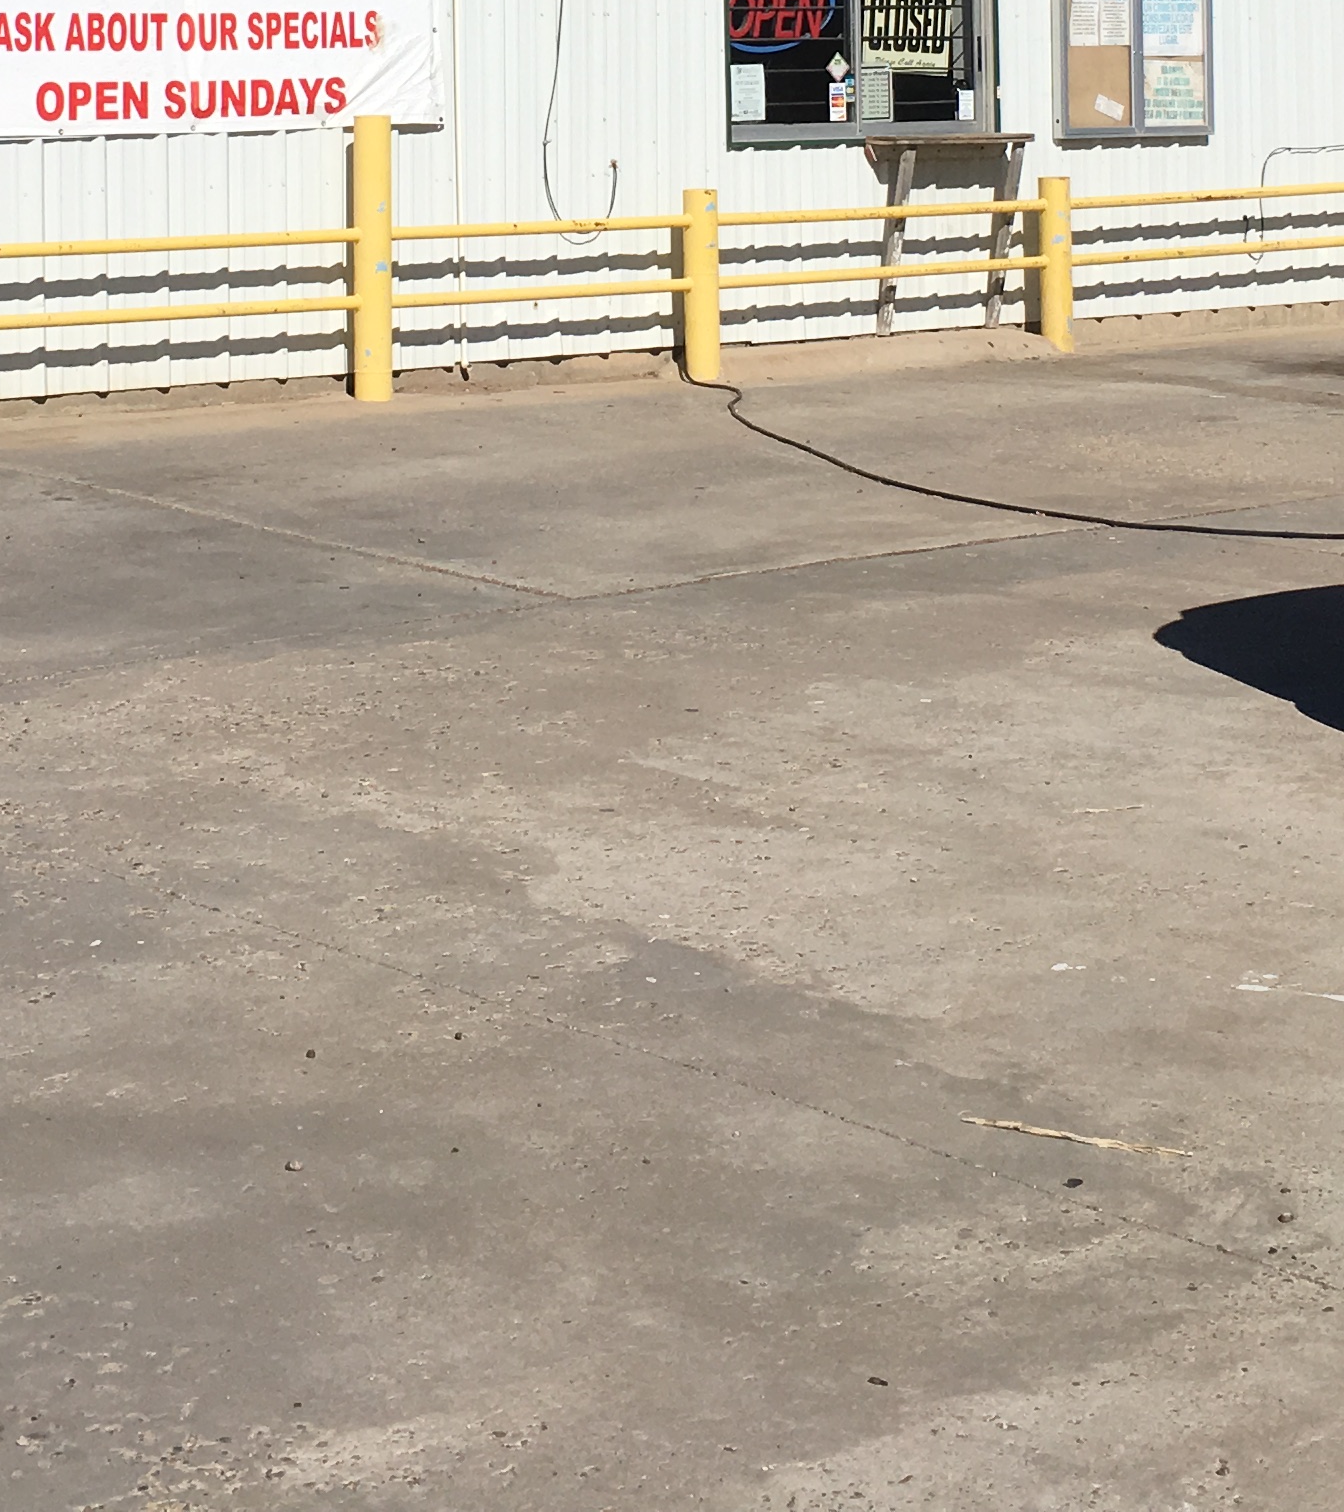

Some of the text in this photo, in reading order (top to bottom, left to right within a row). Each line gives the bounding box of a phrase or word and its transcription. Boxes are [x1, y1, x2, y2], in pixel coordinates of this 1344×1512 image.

[65, 12, 169, 52] ABOUT
[176, 12, 239, 51] OUR
[247, 11, 382, 51] SPECIALS
[36, 77, 348, 122] OPEN SUNDAYS
